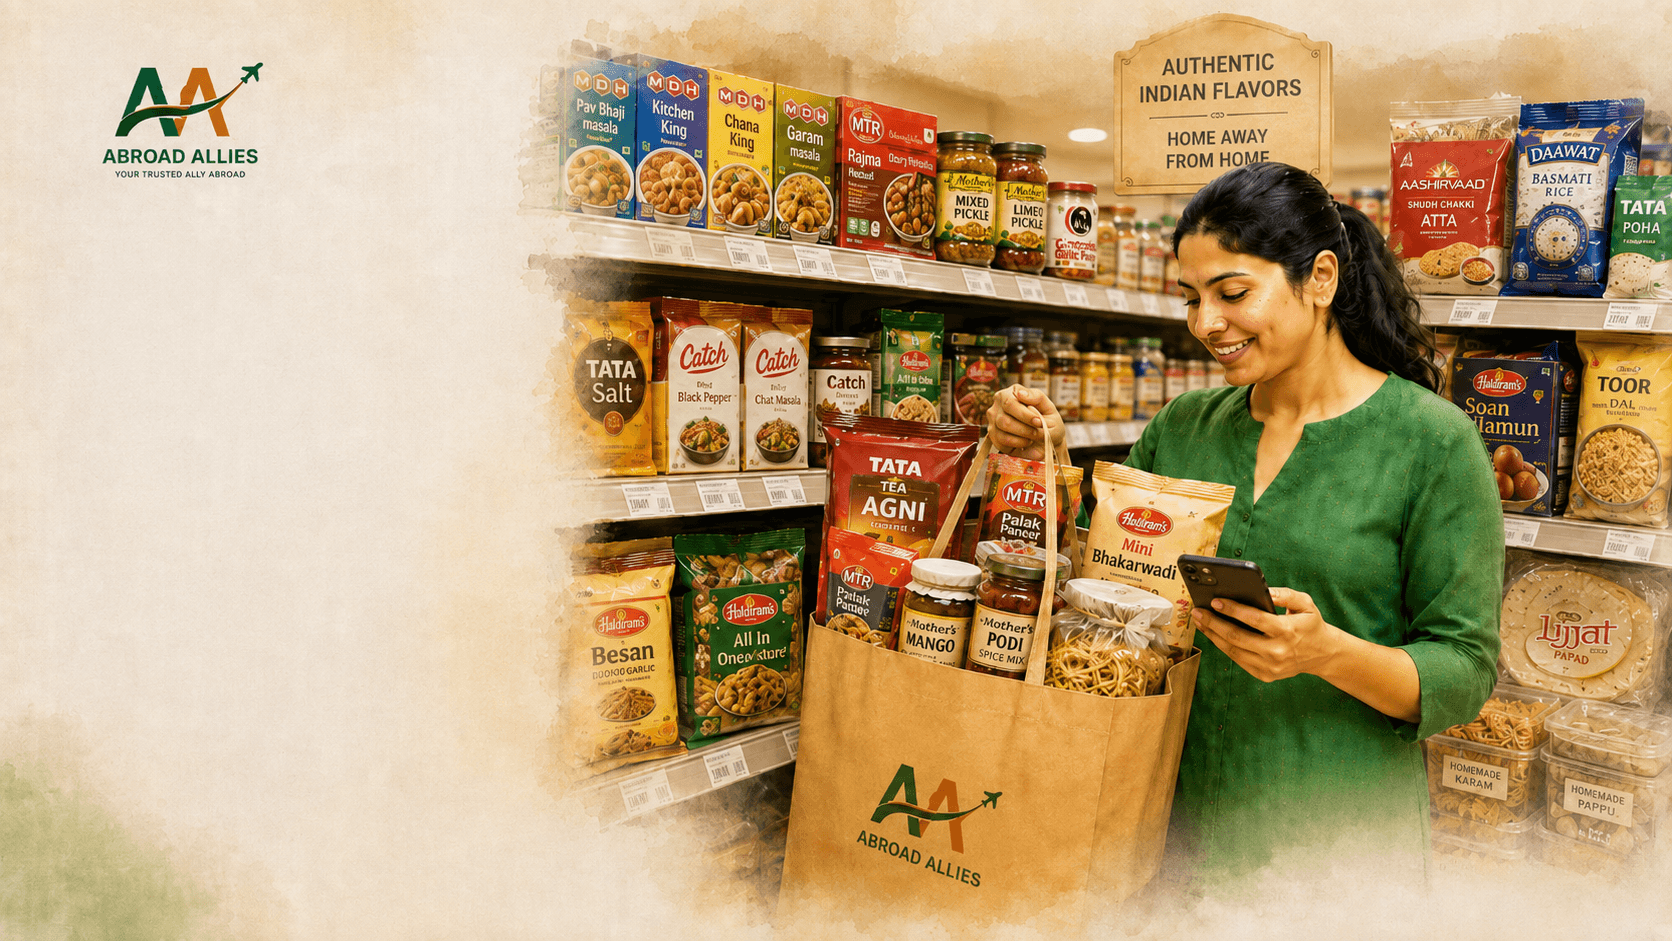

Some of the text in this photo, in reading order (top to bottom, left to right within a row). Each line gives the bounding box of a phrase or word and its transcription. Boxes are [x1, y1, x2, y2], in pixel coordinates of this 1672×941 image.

[1162, 53, 1275, 76] AUTHENTIC
[575, 75, 627, 96] MDH
[648, 77, 699, 97] MDH
[1139, 78, 1302, 103] INDIAN FLAVORS
[577, 98, 625, 122] Pav Bhaji
[652, 98, 694, 121] Kitchen
[719, 92, 765, 109] MDH
[725, 113, 760, 134] Chana
[784, 105, 827, 123] MDH
[582, 119, 619, 135] masala
[661, 119, 687, 140] King
[787, 125, 824, 146] Garam
[852, 116, 881, 136] MTR
[730, 132, 755, 153] King
[1167, 128, 1268, 147] HOME AWAY
[790, 146, 820, 162] masala
[848, 148, 881, 168] Rajma
[1166, 150, 1270, 169] FROM HOME
[1530, 145, 1600, 162] DAAWAT
[1400, 179, 1485, 190] AASHIRVAAD
[1532, 172, 1592, 185] BASMATI
[955, 194, 989, 208] MIXED
[1545, 186, 1574, 197] RICE
[1407, 200, 1475, 209] SHUDH CHAKKI
[1620, 199, 1667, 215] TATA
[954, 208, 990, 221] PICKLE
[1011, 217, 1043, 230] PICKLE
[1421, 213, 1457, 228] ATTA
[1623, 221, 1661, 234] POHA
[679, 340, 729, 370] Catch
[755, 347, 800, 375] Catch
[586, 359, 637, 379] TATA
[592, 381, 633, 403] Salt
[827, 375, 866, 390] Catch
[1597, 376, 1651, 395] TOOR
[678, 391, 732, 405] Black Pepper
[755, 394, 802, 406] Chat Masala
[1464, 397, 1510, 417] Soan
[1610, 398, 1636, 410] DAL
[869, 456, 922, 477] TATA
[880, 480, 907, 494] TEA
[1006, 486, 1047, 507] MTR
[861, 496, 926, 522] AGNI
[1001, 512, 1041, 531] Palak
[1121, 537, 1154, 557] Mini
[1092, 548, 1177, 580] Bhakarwadi
[843, 569, 871, 588] MTR
[909, 618, 957, 635] Mother's
[982, 617, 1034, 634] Mother's
[1536, 613, 1619, 650] Lijjat
[733, 631, 770, 648] All In
[906, 631, 955, 653] MANGO
[987, 631, 1024, 652] PODI
[591, 645, 655, 666] Besan
[978, 648, 1026, 665] SPICE MIX
[1553, 650, 1589, 665] PAPAD
[626, 664, 656, 675] GARLIC
[1450, 760, 1501, 781] HOMEMADE
[1455, 774, 1493, 791] KARAM
[1571, 784, 1625, 806] HOMEMADE
[1578, 799, 1616, 817] PAPPU
[856, 830, 981, 887] ABROAD ALLIES
